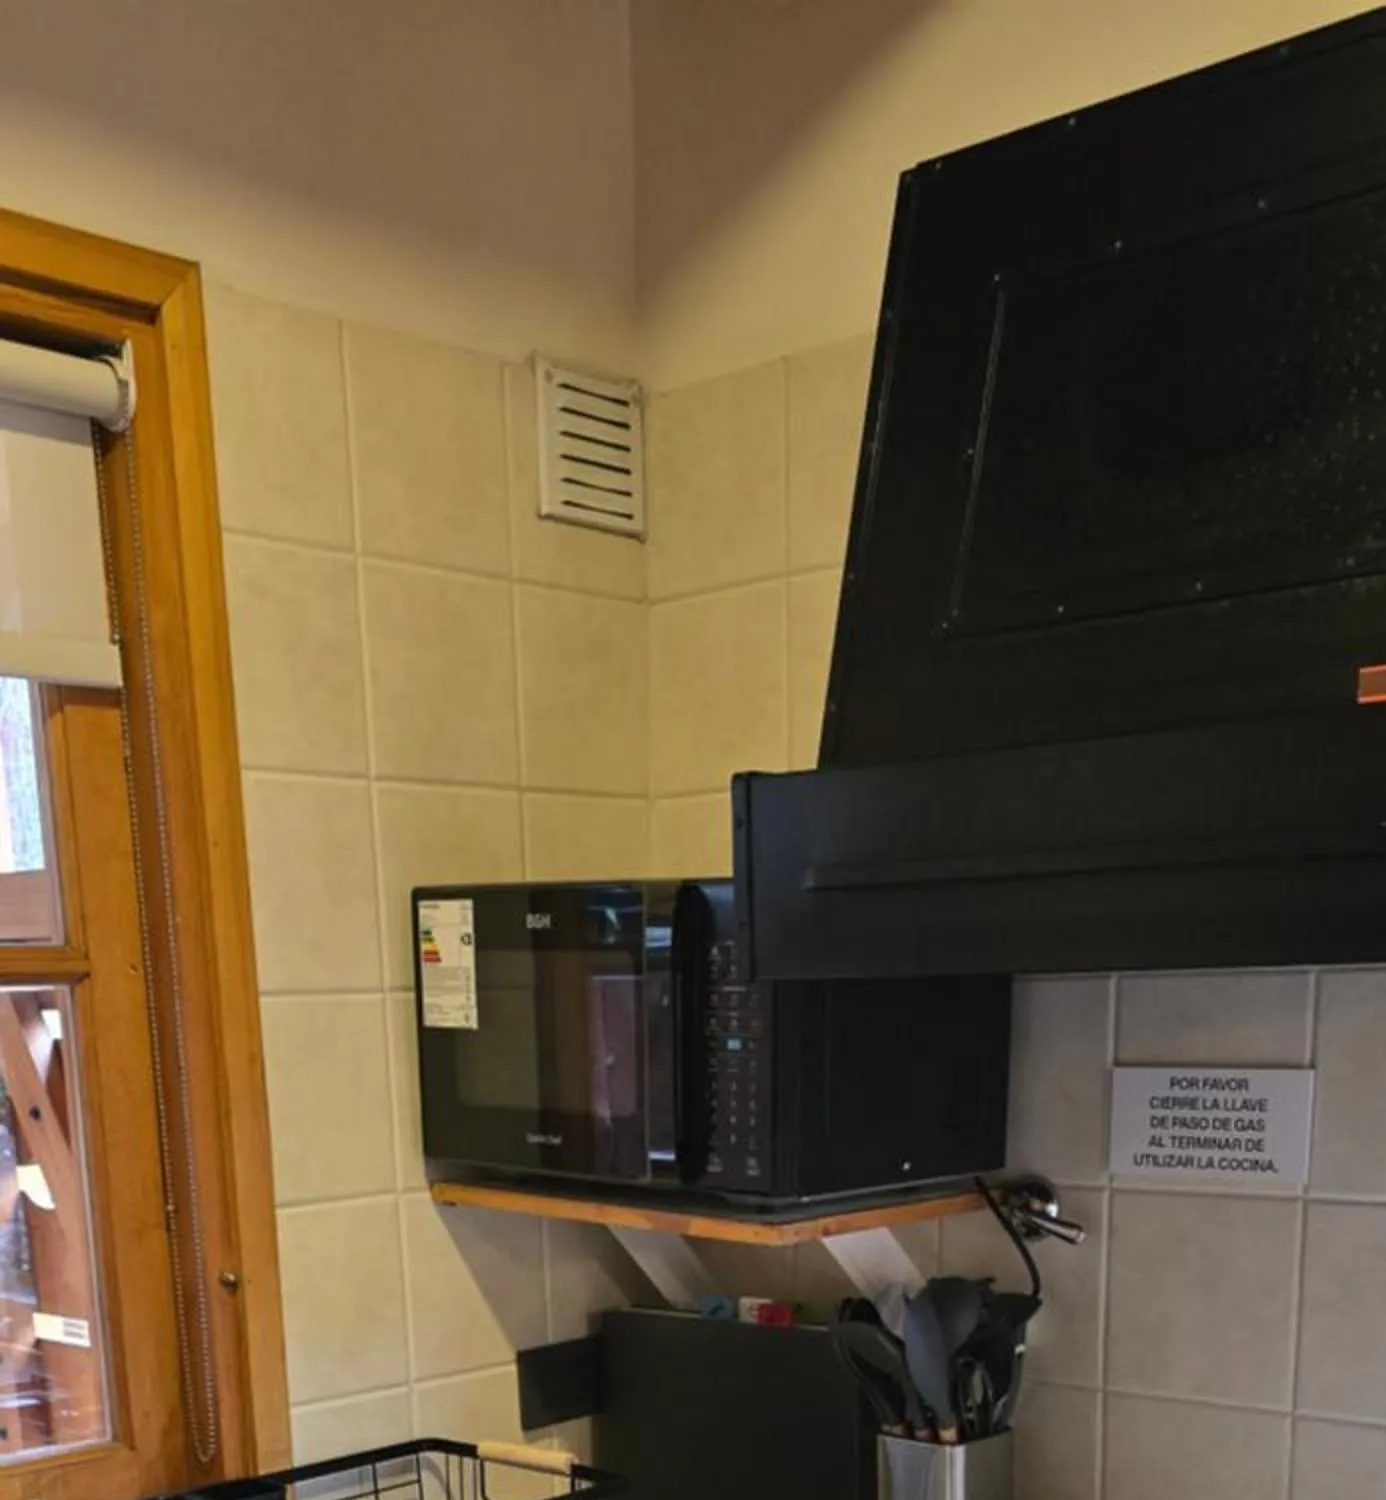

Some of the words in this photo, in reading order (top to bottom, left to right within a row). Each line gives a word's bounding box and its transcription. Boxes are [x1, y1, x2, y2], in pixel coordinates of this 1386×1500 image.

[1169, 1076, 1199, 1091] POR
[1202, 1077, 1249, 1091] FAVOR
[1148, 1096, 1200, 1110] CIERRE
[1202, 1098, 1220, 1111] LA
[1223, 1098, 1269, 1112] LLAVE
[1150, 1115, 1169, 1130] DE
[1172, 1116, 1210, 1131] PASO
[1212, 1117, 1232, 1131] DE
[1234, 1118, 1265, 1132] GAS
[1148, 1135, 1166, 1148] AL
[1171, 1136, 1242, 1151] TERMINAR
[1245, 1138, 1265, 1152] DE
[1133, 1154, 1195, 1169] UTILIZAR
[1197, 1156, 1216, 1169] LA
